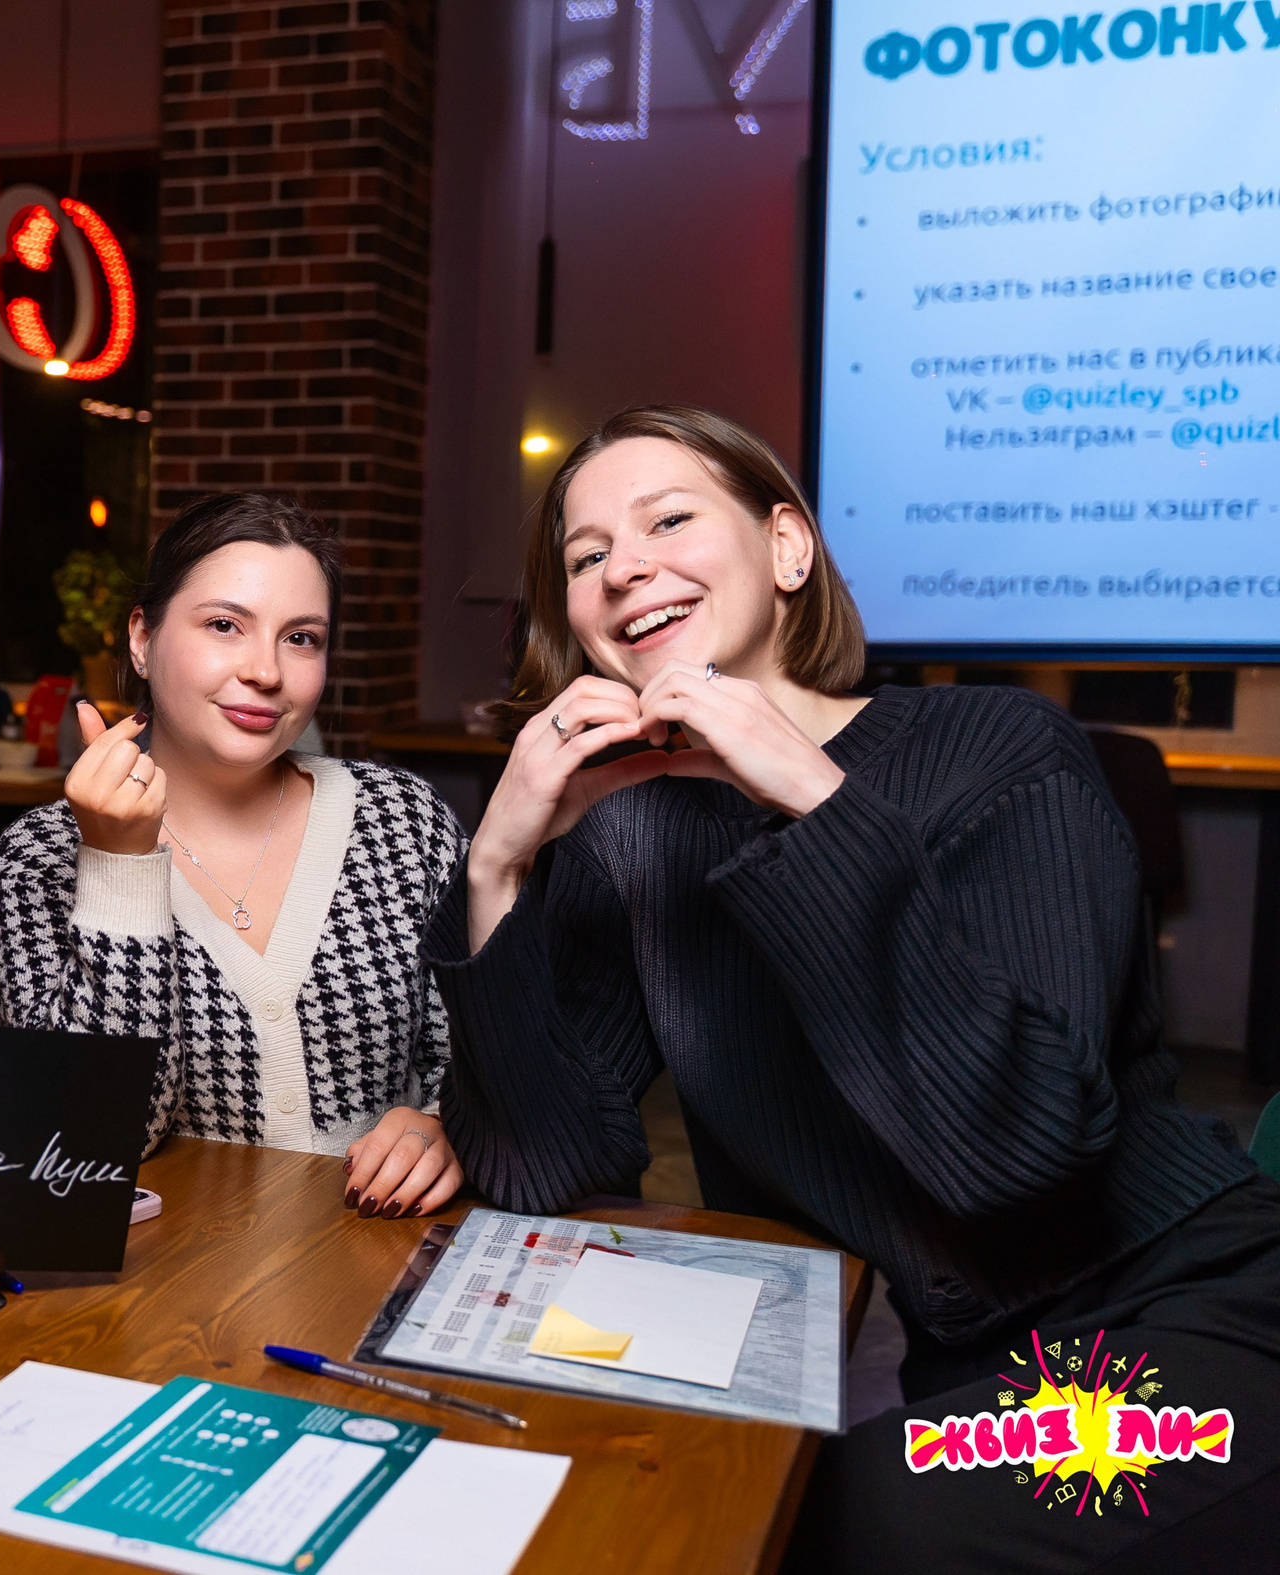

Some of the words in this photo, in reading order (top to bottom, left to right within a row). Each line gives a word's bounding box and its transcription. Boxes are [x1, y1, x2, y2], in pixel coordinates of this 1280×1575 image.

[859, 134, 1045, 174] Условия:
[919, 200, 1080, 230] выложить
[1090, 182, 1280, 224] фотографи
[913, 277, 1032, 310] указать
[1041, 268, 1193, 297] название
[910, 353, 1060, 379] отметить
[1067, 346, 1120, 371] нас
[1129, 346, 1147, 369] в
[1156, 338, 1280, 376] публик
[946, 387, 989, 413] VK
[1022, 376, 1239, 415] @quizley_spb
[945, 421, 1135, 453] Нельзяграм
[905, 498, 1063, 525] поставить
[1070, 497, 1136, 522] наш
[1144, 497, 1260, 521] хэштег
[903, 569, 1089, 600] победитель
[1097, 567, 1280, 602] выбираетс
